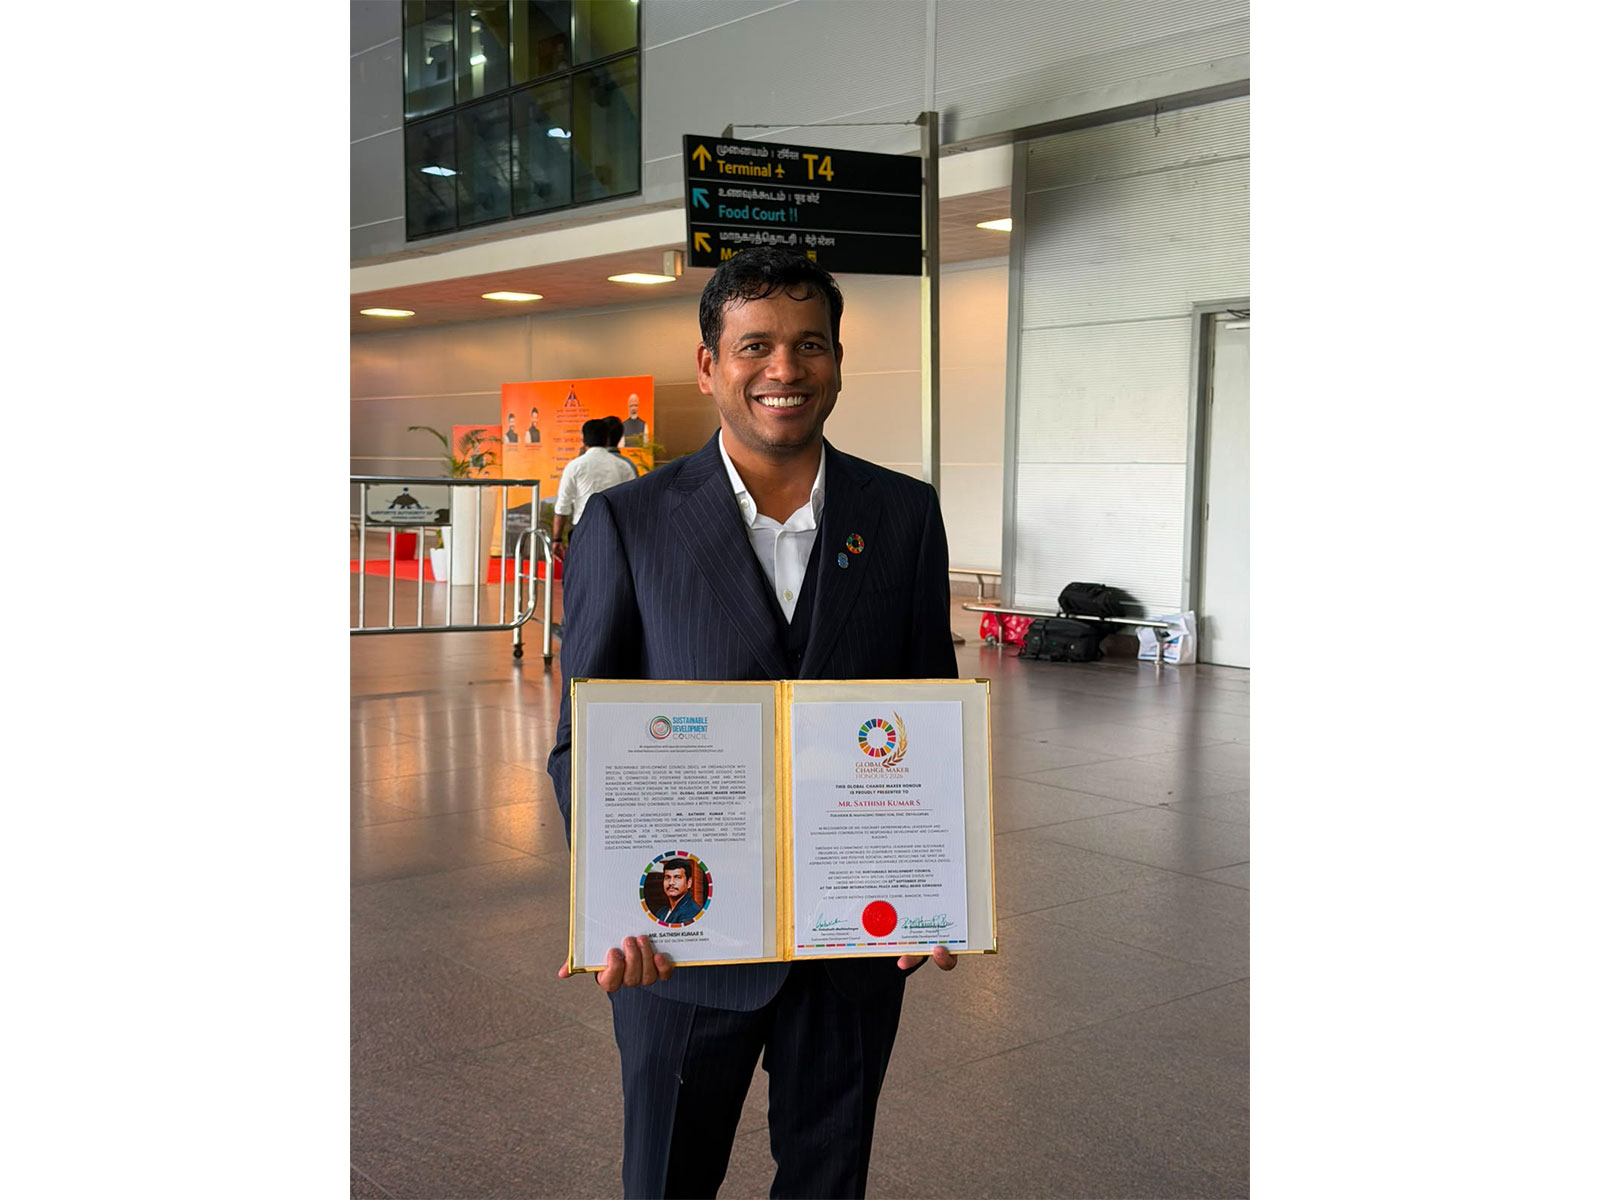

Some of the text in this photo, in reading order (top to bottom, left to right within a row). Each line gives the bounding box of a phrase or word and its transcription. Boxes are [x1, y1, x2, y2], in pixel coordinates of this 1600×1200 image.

[717, 160, 772, 178] Terminal
[802, 154, 834, 182] T4
[718, 204, 786, 222] Food Court
[672, 716, 708, 724] SUSTAINABLE
[672, 725, 708, 733] DEVELOPMENT
